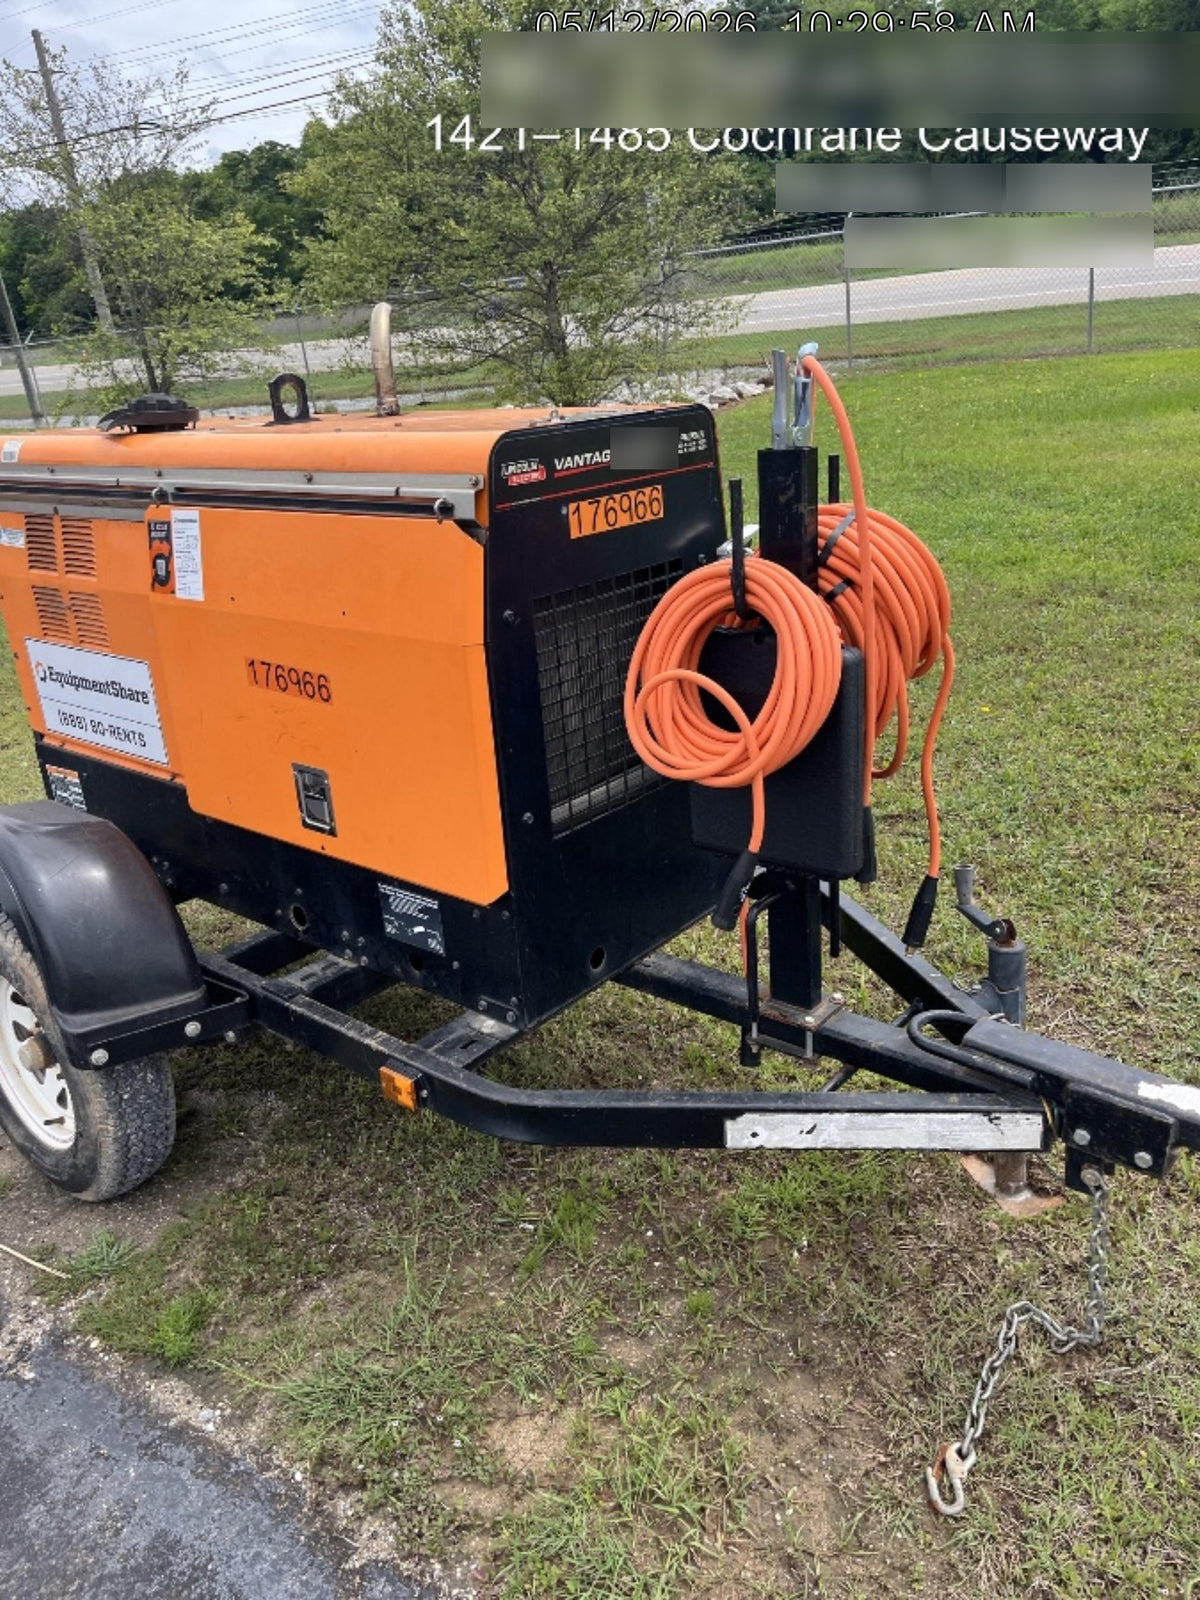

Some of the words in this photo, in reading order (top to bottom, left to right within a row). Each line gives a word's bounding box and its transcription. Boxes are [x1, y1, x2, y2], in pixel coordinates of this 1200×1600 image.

[554, 449, 611, 470] VANTAG
[572, 487, 661, 534] 176966
[47, 665, 149, 705] EquipmentShare
[248, 659, 331, 703] 176966
